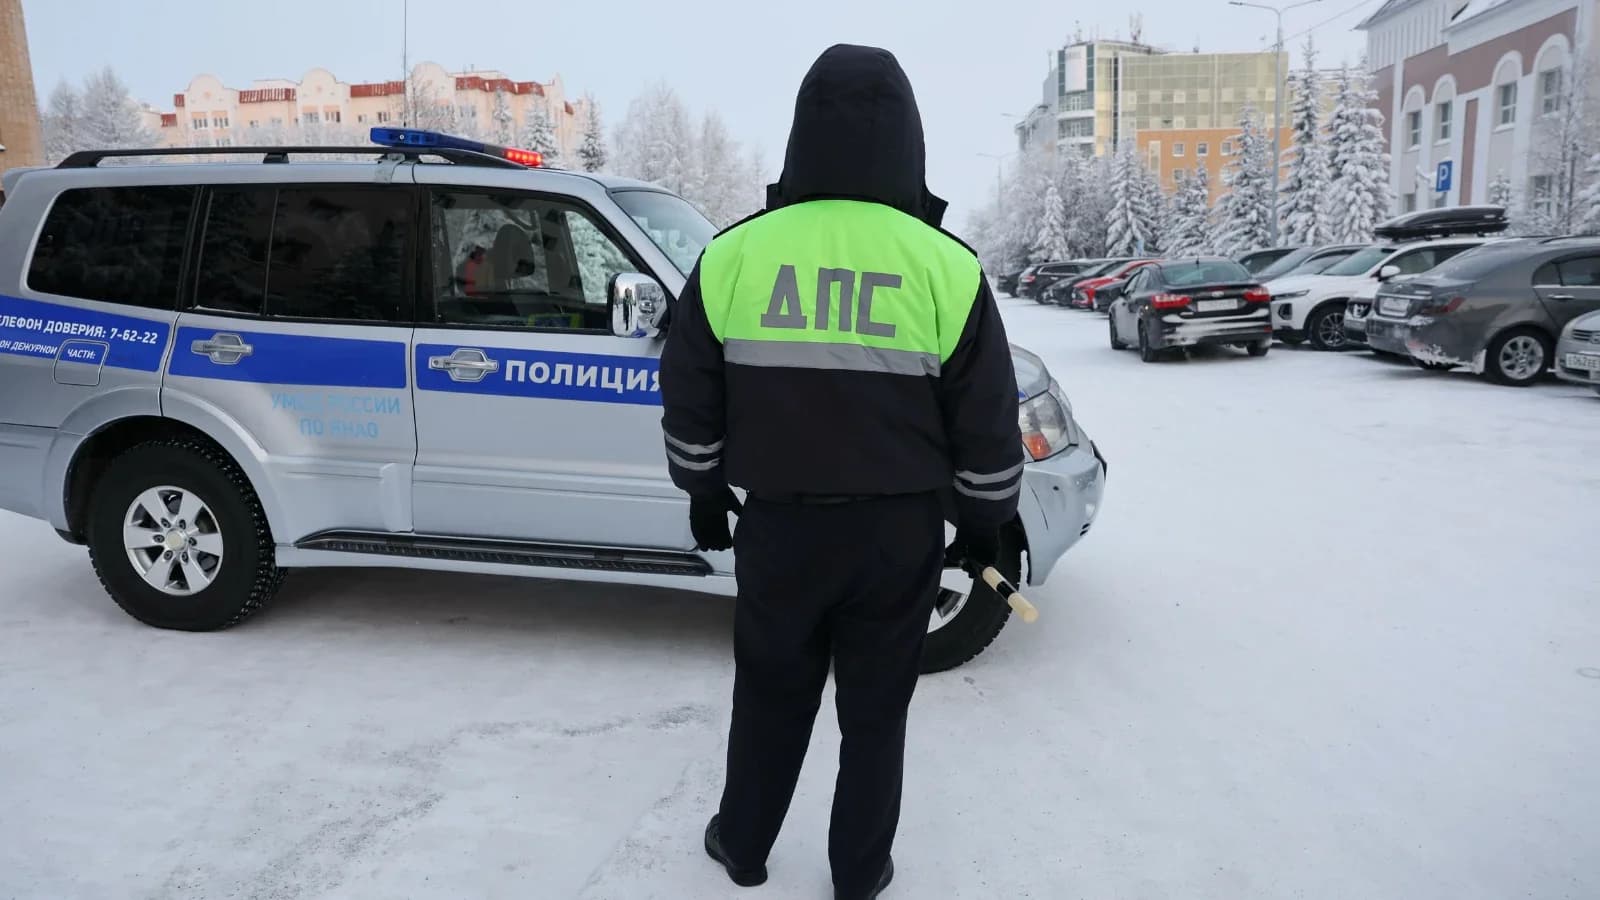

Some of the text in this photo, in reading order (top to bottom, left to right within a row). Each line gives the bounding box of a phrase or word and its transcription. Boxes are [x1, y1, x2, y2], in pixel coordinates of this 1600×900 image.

[760, 264, 903, 338] ДПС
[0, 315, 158, 344] ЛЕФОН ДОВЕРИЯ: 7-62-22
[67, 349, 97, 359] ЧАСТИ:
[505, 360, 660, 393] ПОЛИЦИЯ
[300, 416, 324, 436] ПО
